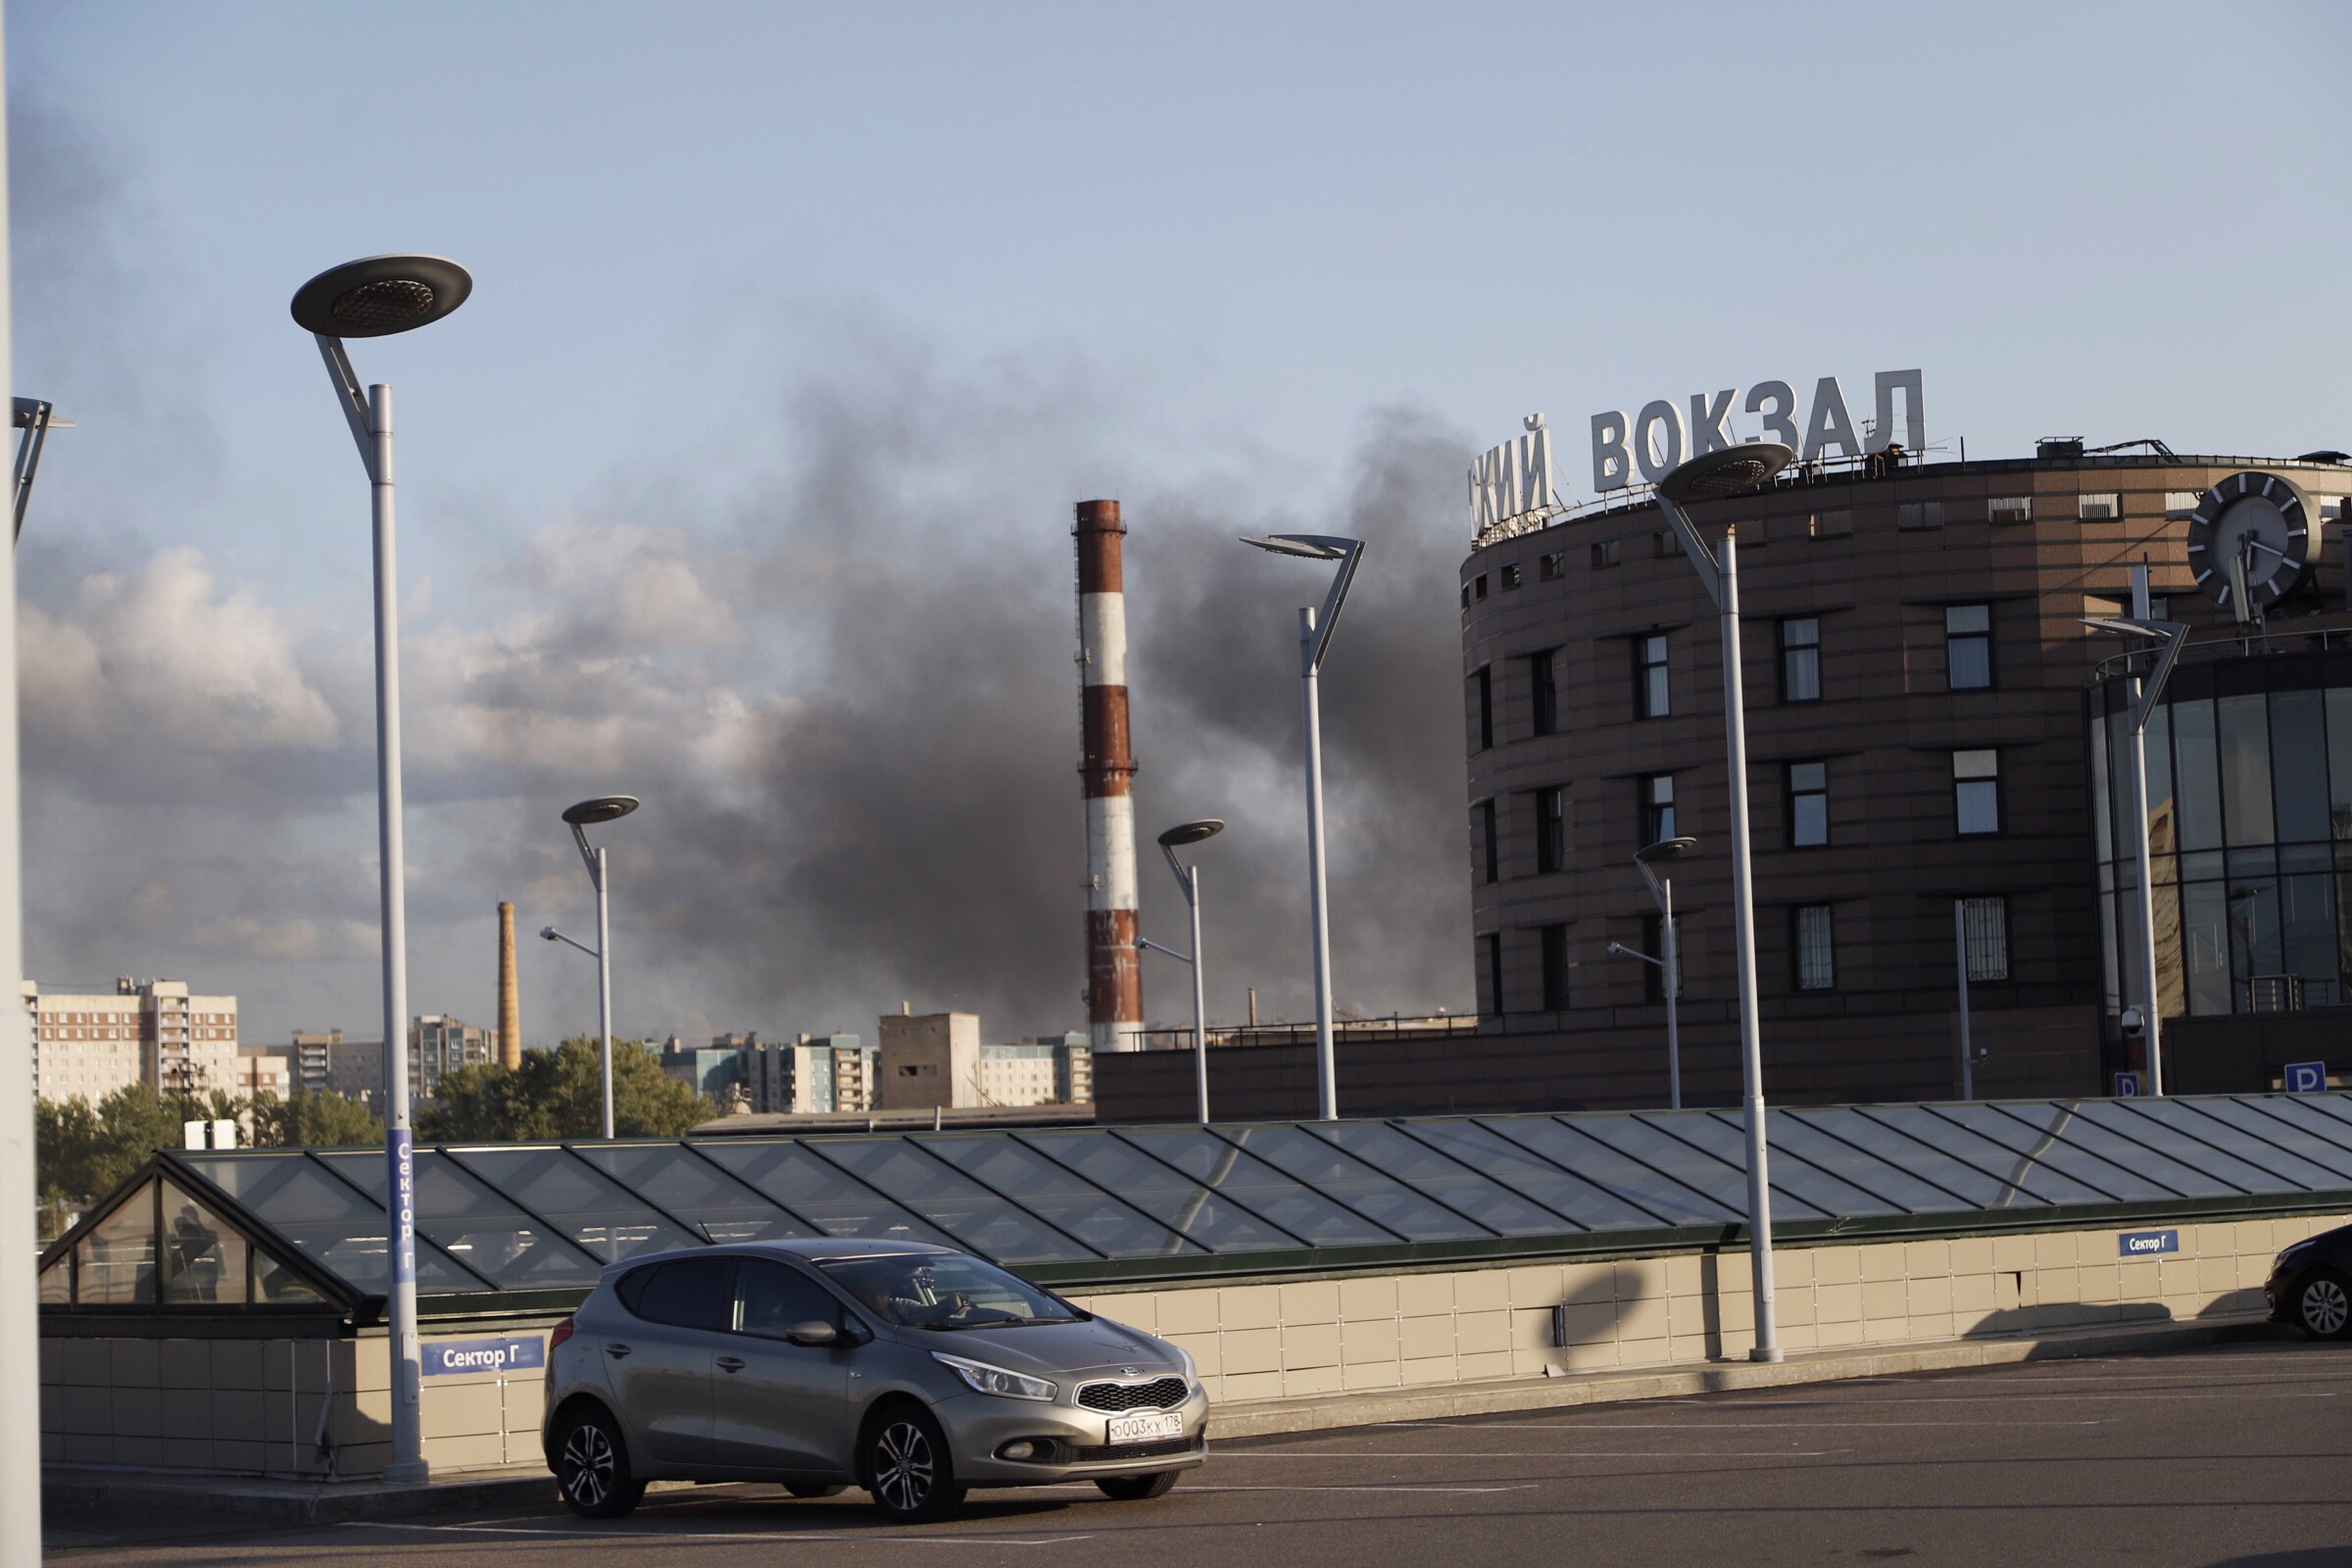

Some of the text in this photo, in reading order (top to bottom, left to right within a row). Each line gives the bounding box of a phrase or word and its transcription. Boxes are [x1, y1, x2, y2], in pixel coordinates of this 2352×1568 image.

[1591, 368, 1926, 493] ВОКЗАЛ
[2296, 1068, 2318, 1092] P
[398, 1143, 414, 1269] Сектор Г
[2129, 1235, 2167, 1251] Сектор Г
[443, 1345, 519, 1368] Сектор Г
